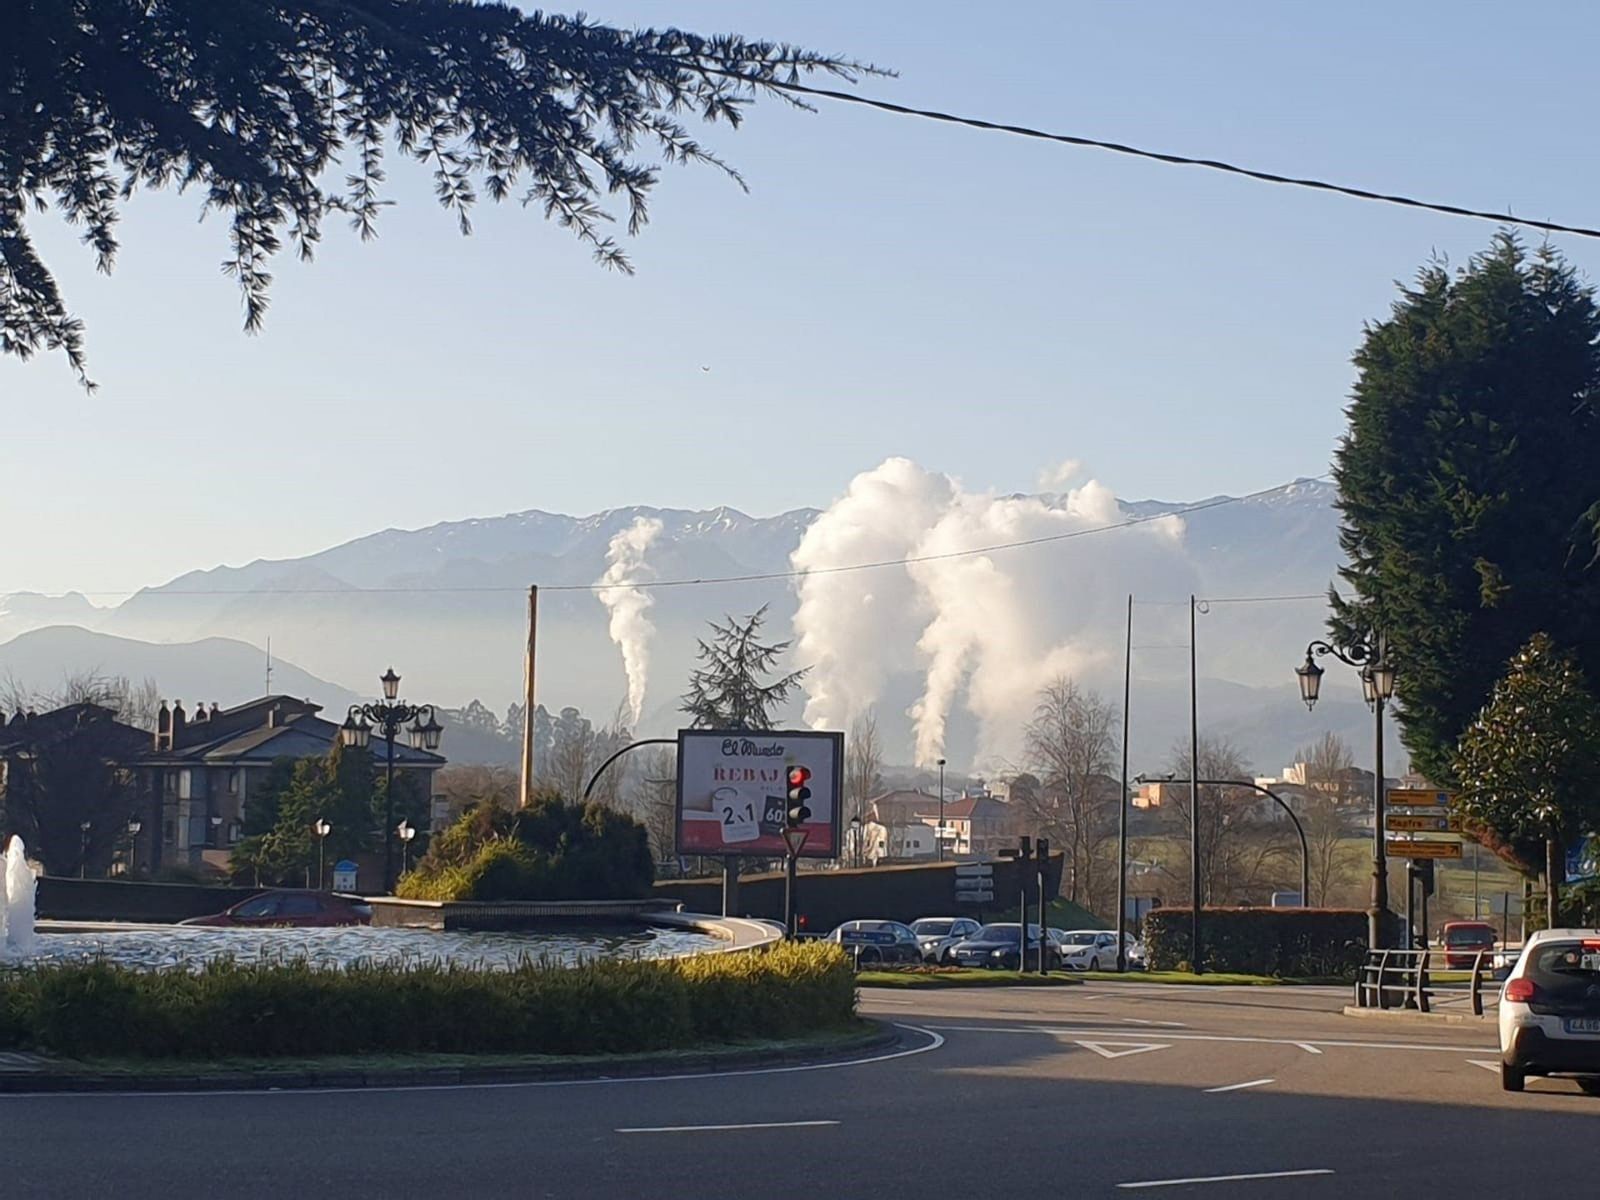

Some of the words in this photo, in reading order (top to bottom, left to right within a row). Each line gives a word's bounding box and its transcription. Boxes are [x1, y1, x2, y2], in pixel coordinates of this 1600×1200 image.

[721, 738, 739, 757] El
[739, 737, 785, 757] Mundo
[714, 767, 780, 781] REBAJ
[766, 807, 785, 824] 60
